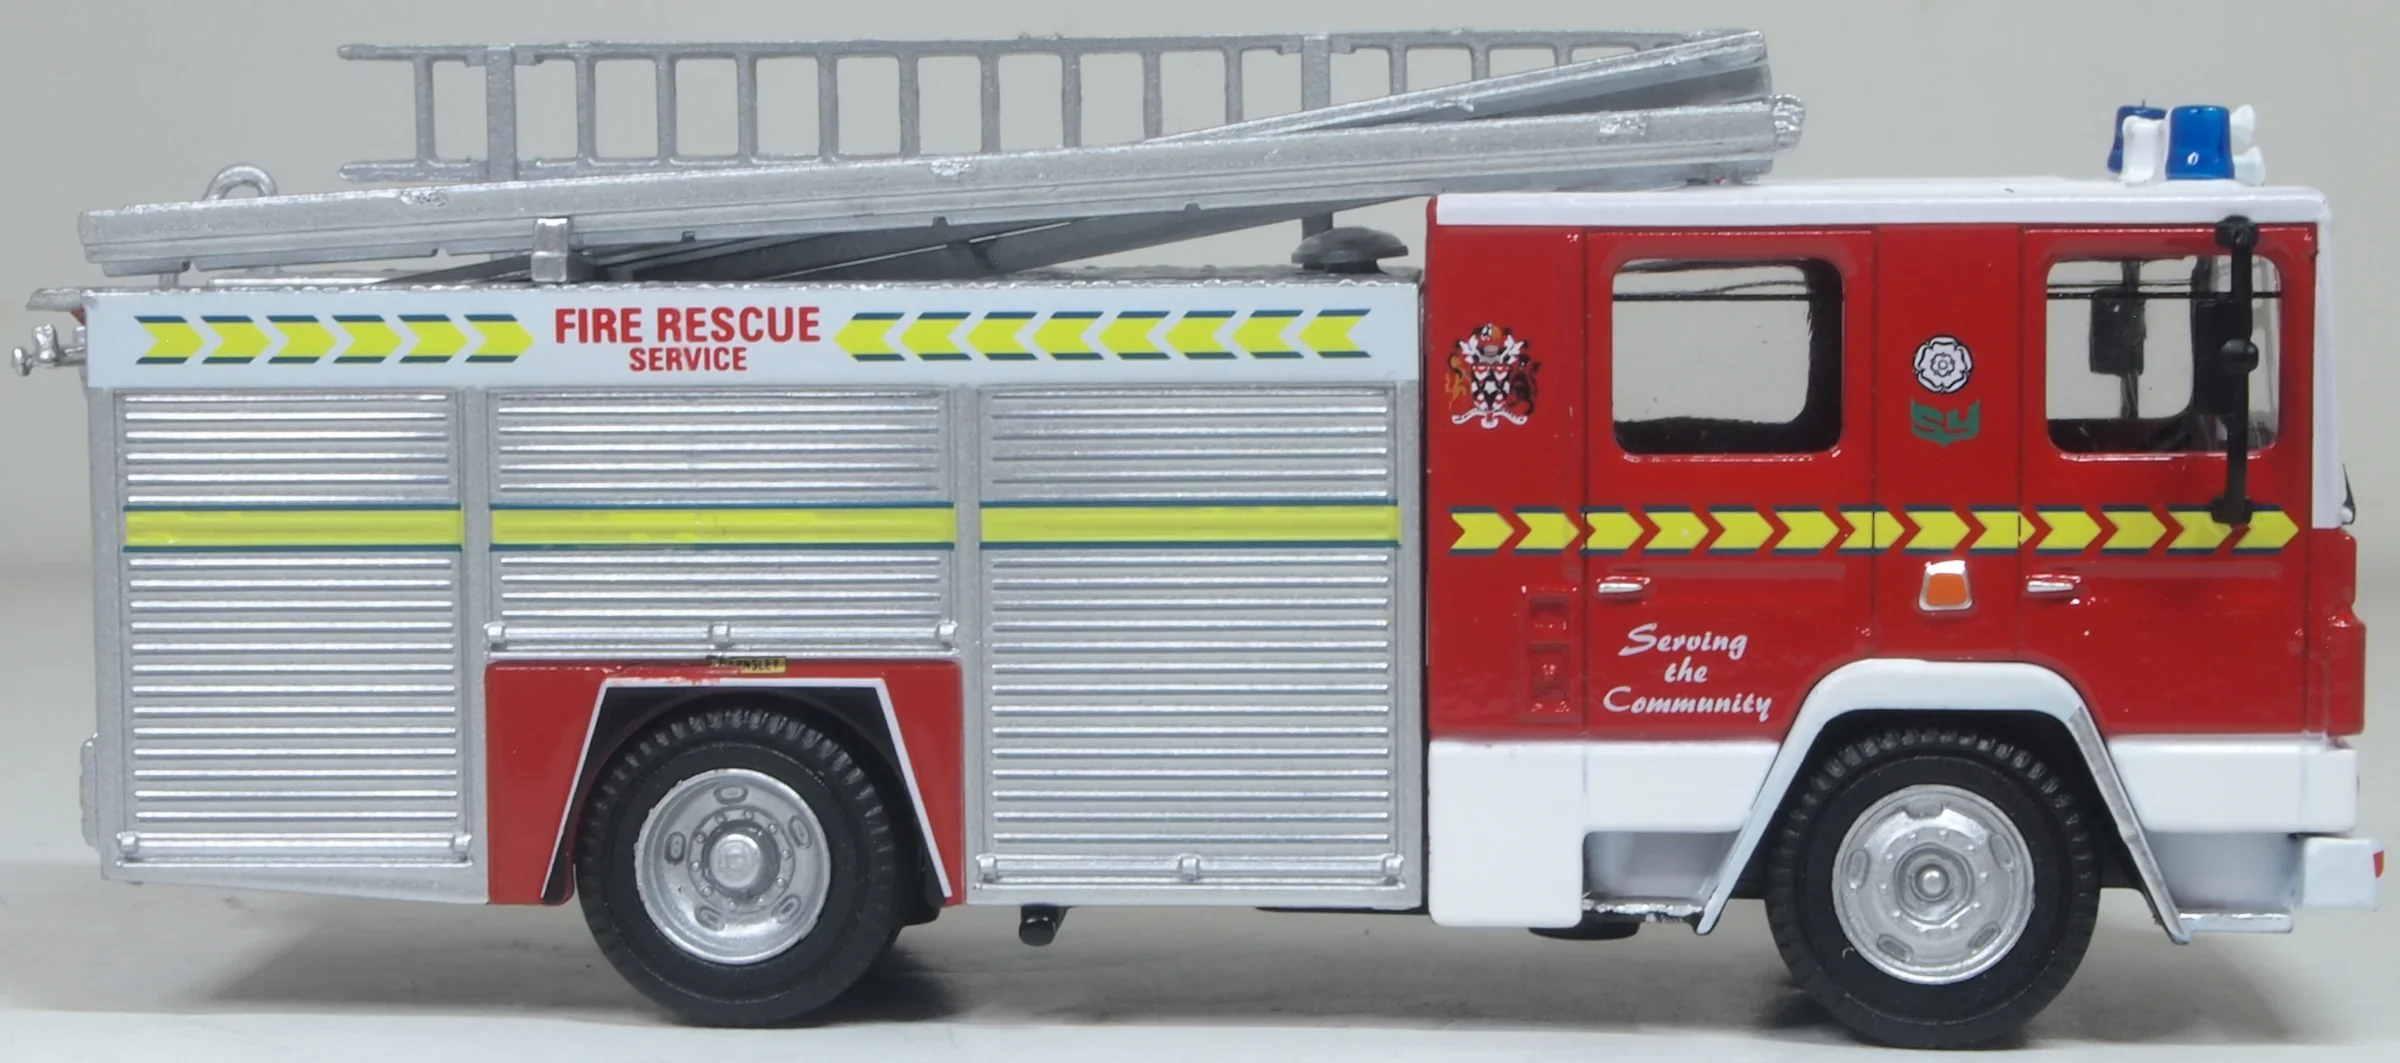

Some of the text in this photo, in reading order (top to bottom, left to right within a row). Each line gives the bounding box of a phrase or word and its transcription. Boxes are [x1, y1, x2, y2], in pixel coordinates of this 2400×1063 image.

[555, 306, 821, 344] FIRE RESCUE
[629, 347, 748, 372] SERVICE
[1617, 622, 1748, 661] Serving
[1663, 656, 1708, 683] the
[1602, 685, 1772, 723] Community
